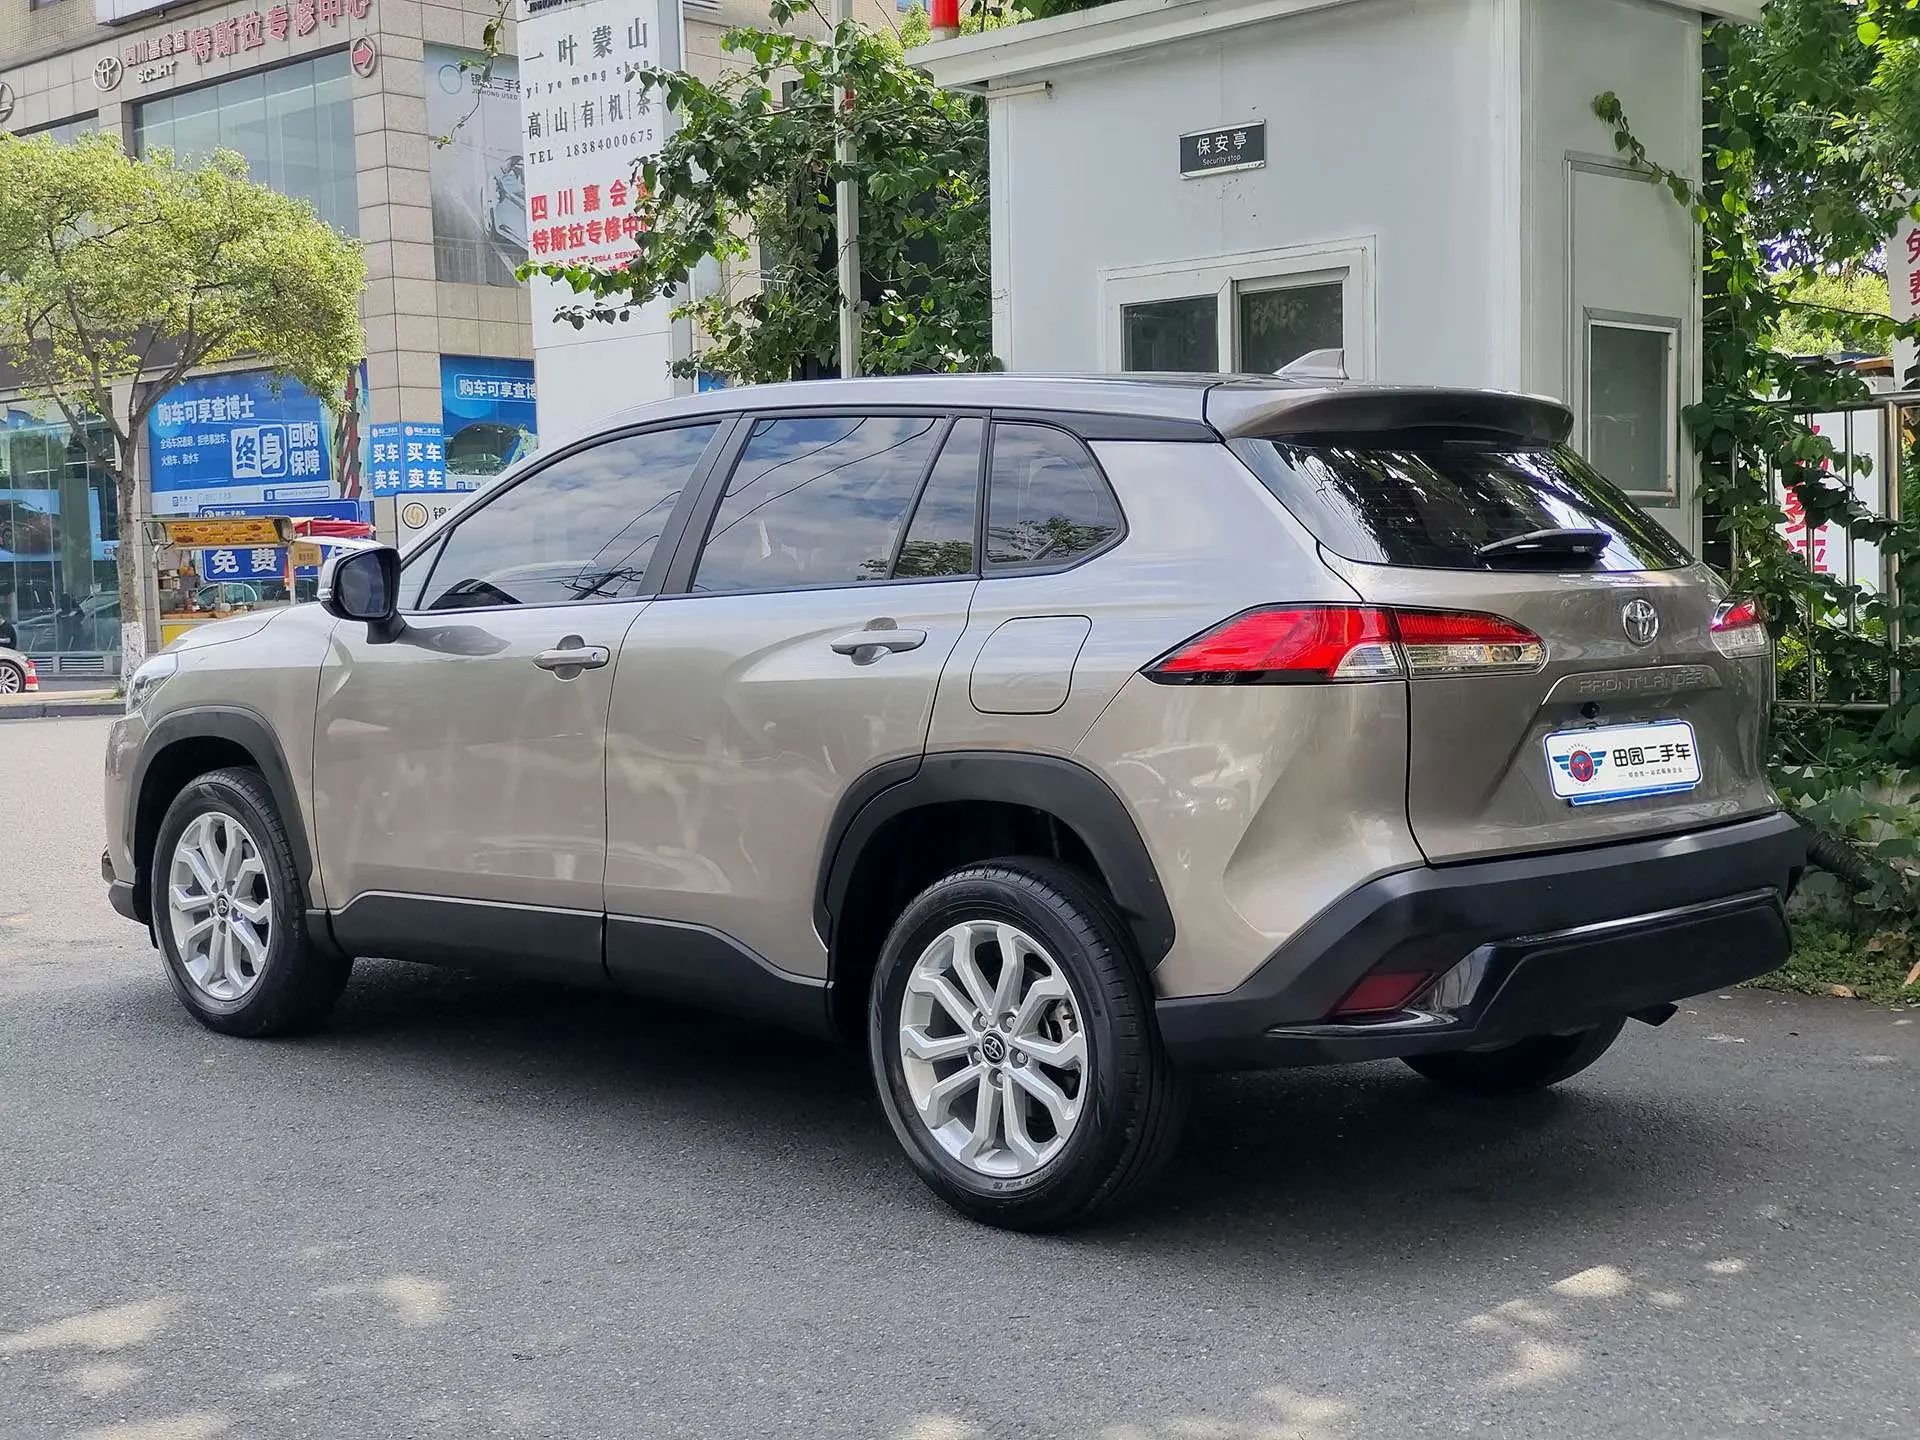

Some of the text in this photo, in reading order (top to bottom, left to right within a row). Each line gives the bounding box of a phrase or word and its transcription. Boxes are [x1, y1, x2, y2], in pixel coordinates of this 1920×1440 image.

[524, 17, 648, 66] 一叶蒙山
[526, 82, 539, 99] yi
[548, 80, 562, 94] ye
[571, 70, 607, 86] meng
[529, 128, 653, 165] TEL 18384000675
[1197, 131, 1247, 156] 保安亭
[1202, 154, 1242, 166] Security stop
[532, 213, 650, 255] 特斯拉专修中
[157, 393, 255, 427] 购车可享查博士
[288, 421, 319, 449] 回购
[235, 433, 284, 471] 终身
[289, 449, 320, 476] 保障
[373, 442, 399, 463] 买车
[407, 442, 442, 462] 买车
[375, 468, 400, 489] 卖车
[408, 468, 443, 488] 卖车
[211, 549, 277, 574] 免费
[1613, 743, 1692, 767] 田园二手车
